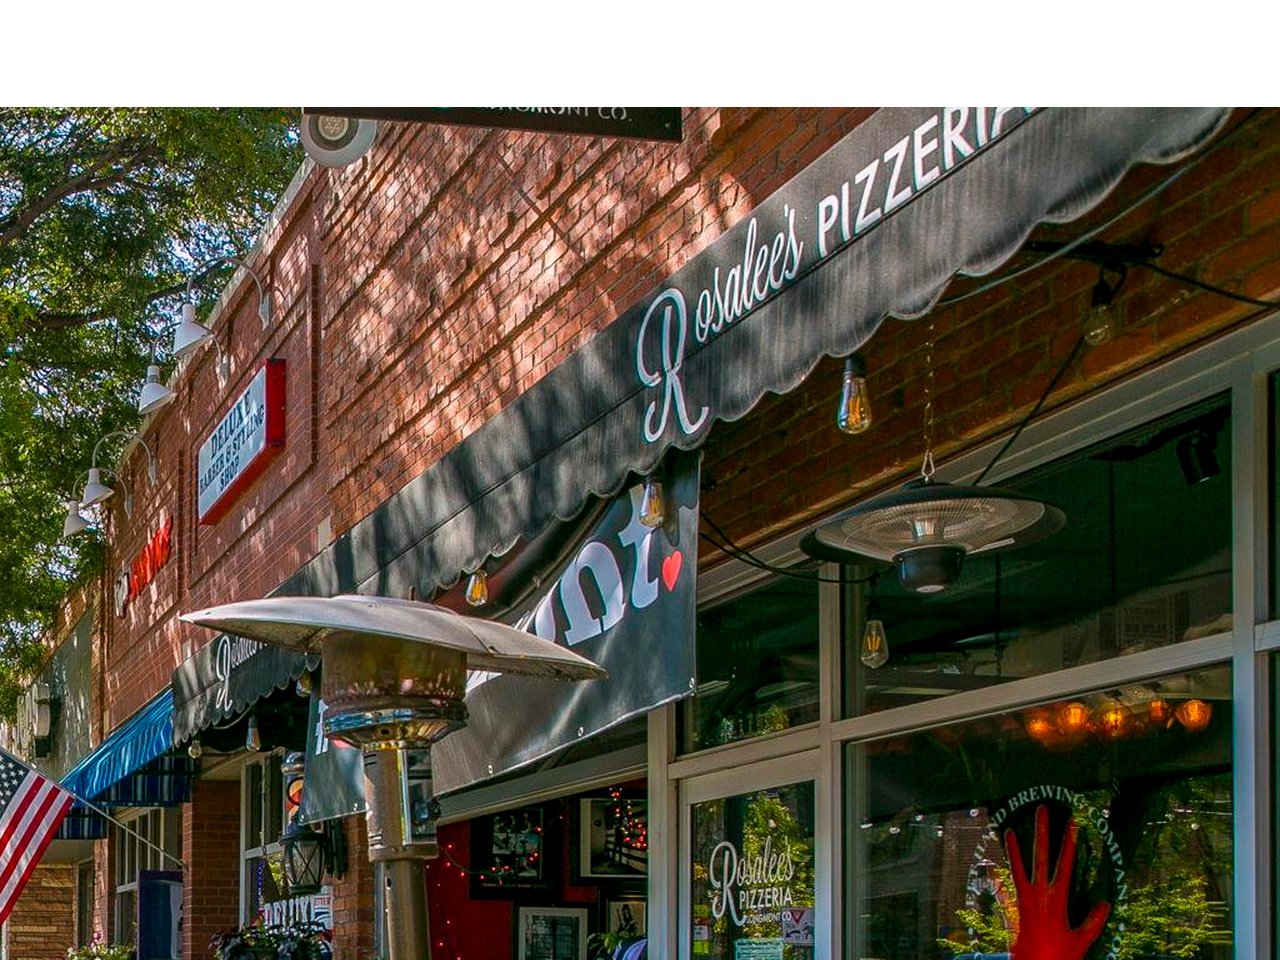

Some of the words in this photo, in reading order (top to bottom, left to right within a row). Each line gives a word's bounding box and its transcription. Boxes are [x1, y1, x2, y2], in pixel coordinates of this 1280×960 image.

[636, 203, 804, 444] Rosalee's
[199, 455, 225, 496] BARBER
[232, 404, 265, 455] STYLING
[210, 389, 251, 460] DELUXE
[219, 455, 240, 491] SHOP
[1007, 784, 1088, 812] BREWING
[1087, 806, 1129, 912] COMPANY
[739, 887, 794, 910] PIZZERIA
